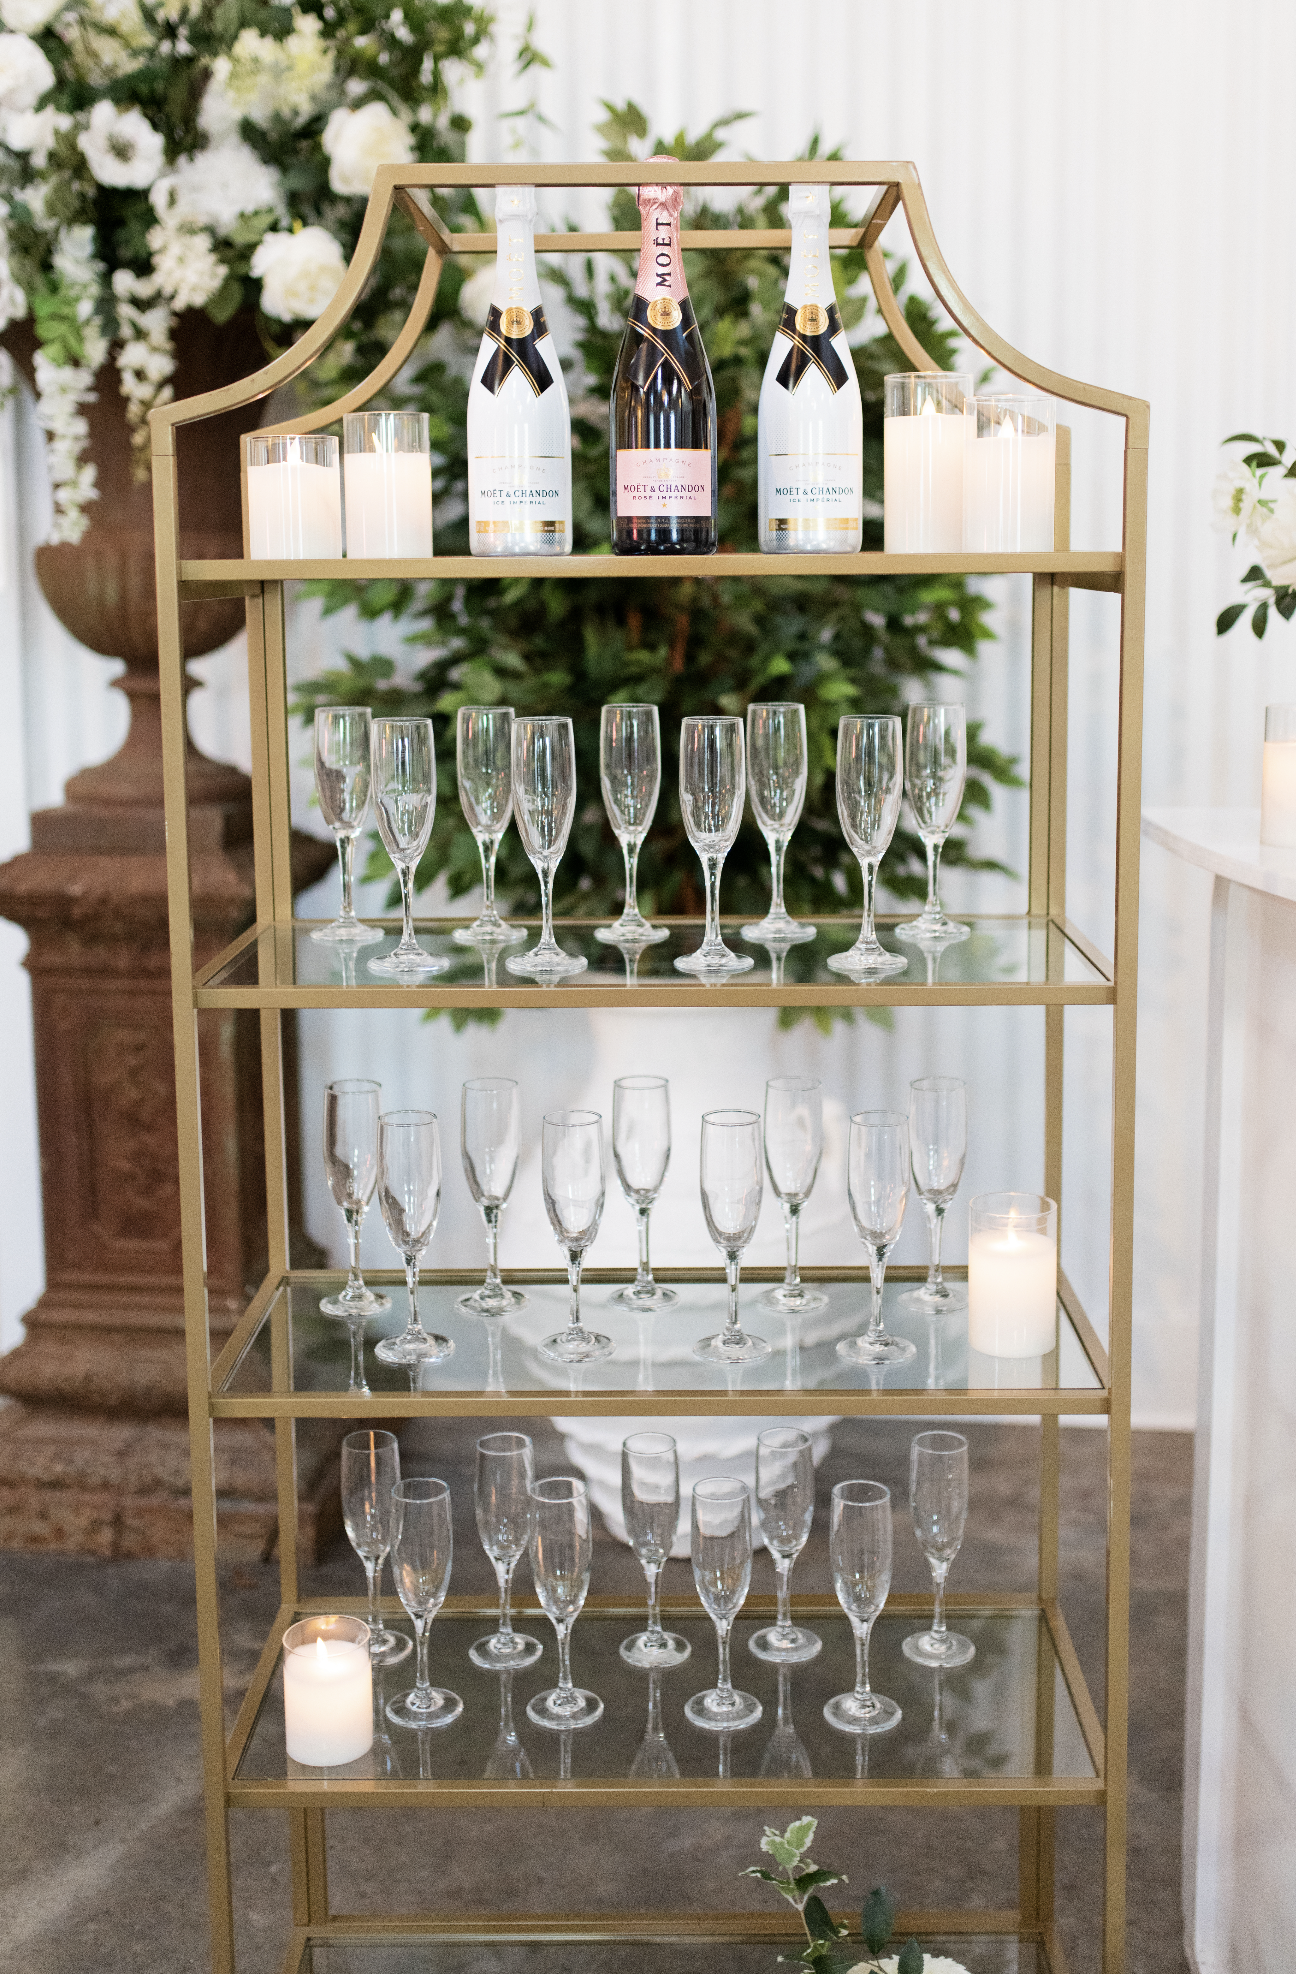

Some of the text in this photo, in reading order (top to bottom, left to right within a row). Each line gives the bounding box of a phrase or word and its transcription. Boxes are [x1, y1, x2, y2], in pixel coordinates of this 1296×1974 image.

[506, 234, 525, 301] MOËT
[653, 217, 672, 288] MOËT
[801, 229, 820, 298] MOËT
[505, 490, 512, 498] &
[513, 489, 560, 498] CHANDON
[623, 482, 705, 493] MOËT & CHANDON
[775, 486, 854, 496] MOËT & CHANDON
